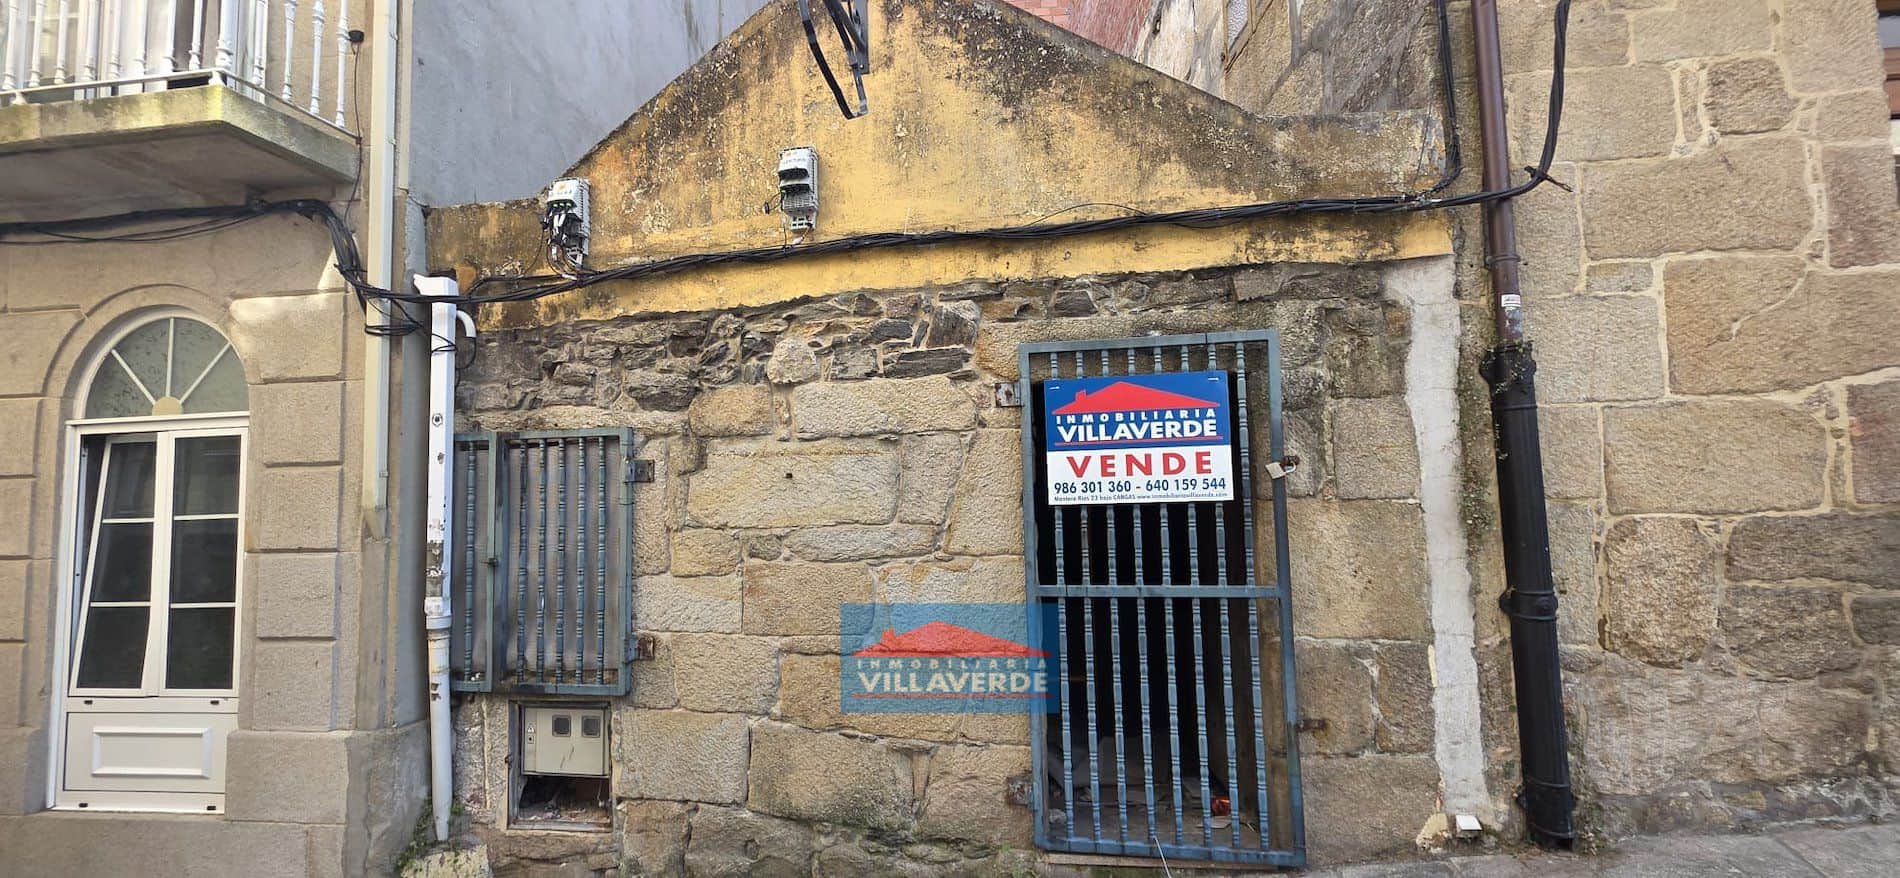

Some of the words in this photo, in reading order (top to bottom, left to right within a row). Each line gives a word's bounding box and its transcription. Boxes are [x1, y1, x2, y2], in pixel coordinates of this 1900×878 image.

[1056, 408, 1216, 425] INMOBILIARIA
[1057, 420, 1217, 443] VILLAVERDE
[1066, 451, 1212, 479] VENDE
[1054, 482, 1077, 494] 986
[1081, 481, 1102, 493] 301
[1108, 480, 1131, 493] 360
[1146, 479, 1169, 491] 640
[1174, 478, 1197, 491] 159
[1202, 477, 1226, 490] 544
